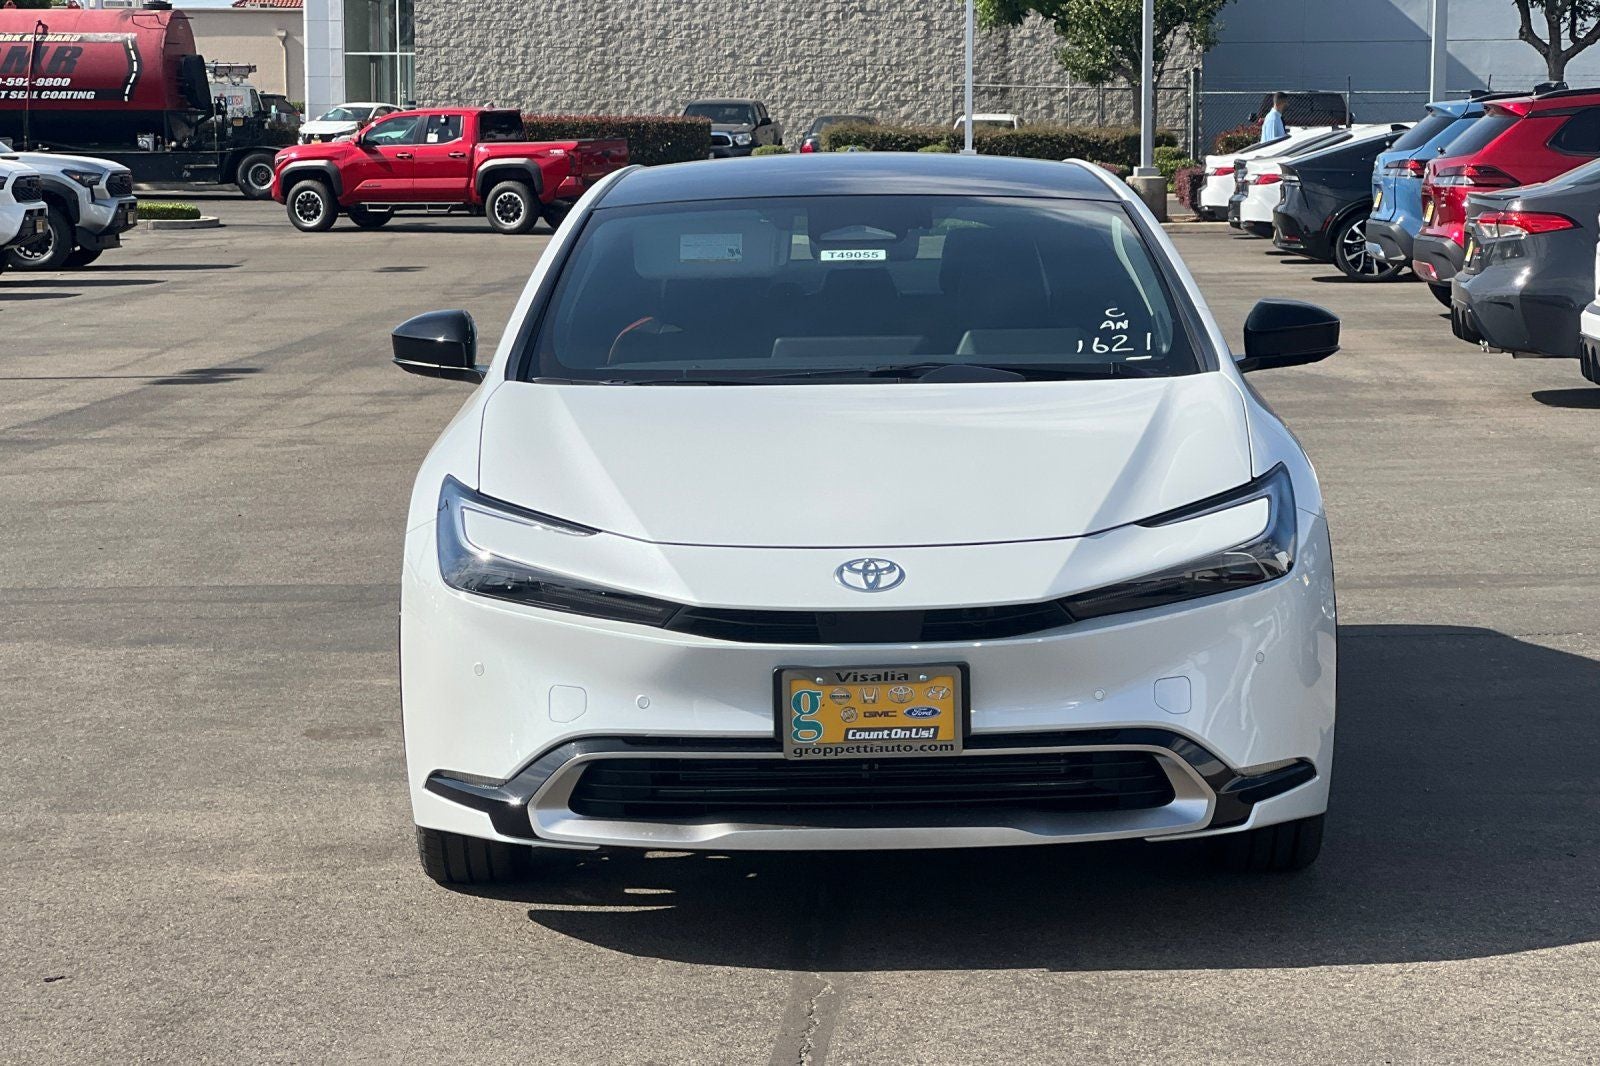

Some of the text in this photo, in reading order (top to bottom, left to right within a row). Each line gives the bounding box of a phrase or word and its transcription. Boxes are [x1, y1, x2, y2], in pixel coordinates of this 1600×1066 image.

[0, 77, 71, 87] -592-9800
[9, 90, 39, 100] SEAL
[41, 90, 96, 100] COATING
[829, 251, 879, 259] T49055
[1100, 320, 1129, 330] AN
[835, 671, 909, 683] Visalia
[847, 728, 934, 740] Count On Us!
[793, 743, 954, 758] groppettiauto.com
